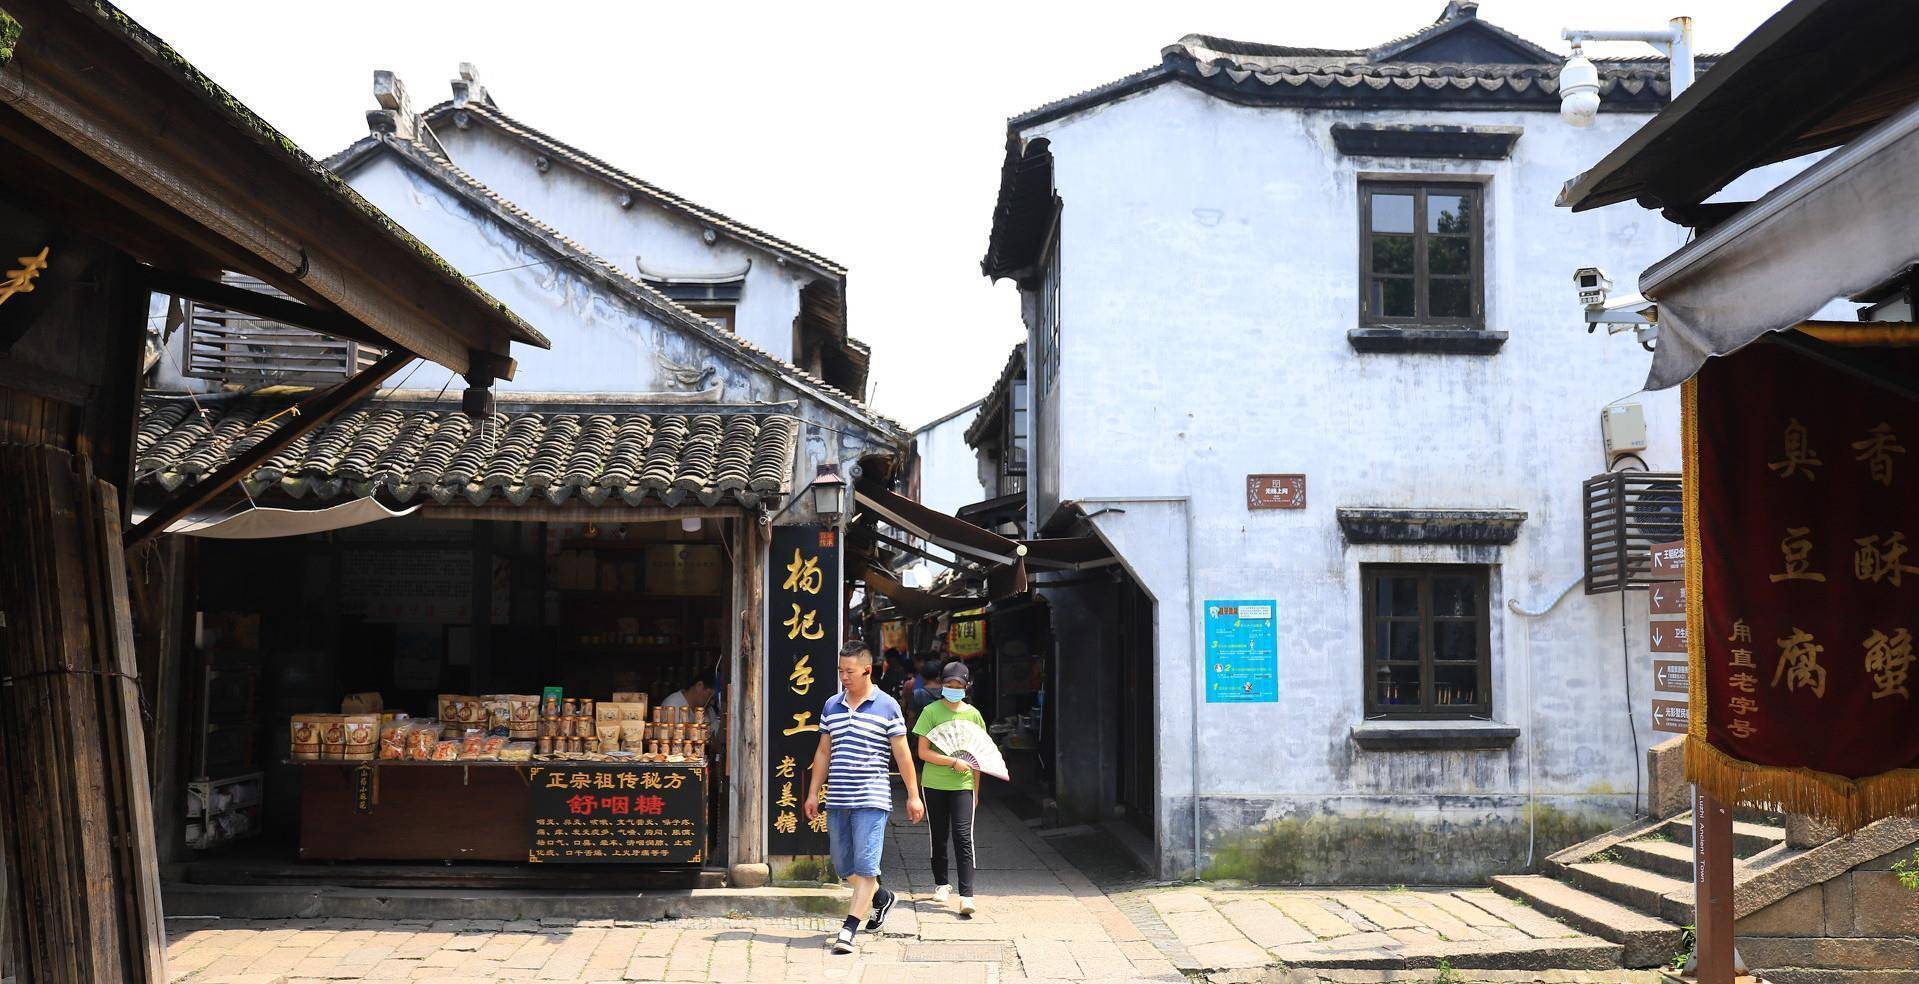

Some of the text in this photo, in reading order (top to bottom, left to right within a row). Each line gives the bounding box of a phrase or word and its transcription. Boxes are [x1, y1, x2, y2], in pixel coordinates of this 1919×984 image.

[1768, 417, 1827, 699] 臭豆腐
[1851, 420, 1919, 700] 香酥蟹
[783, 548, 824, 737] 杨记手工
[546, 772, 687, 790] 正宗祖传秘方
[566, 794, 666, 815] 舒咽糖
[774, 755, 799, 834] 老姜糖
